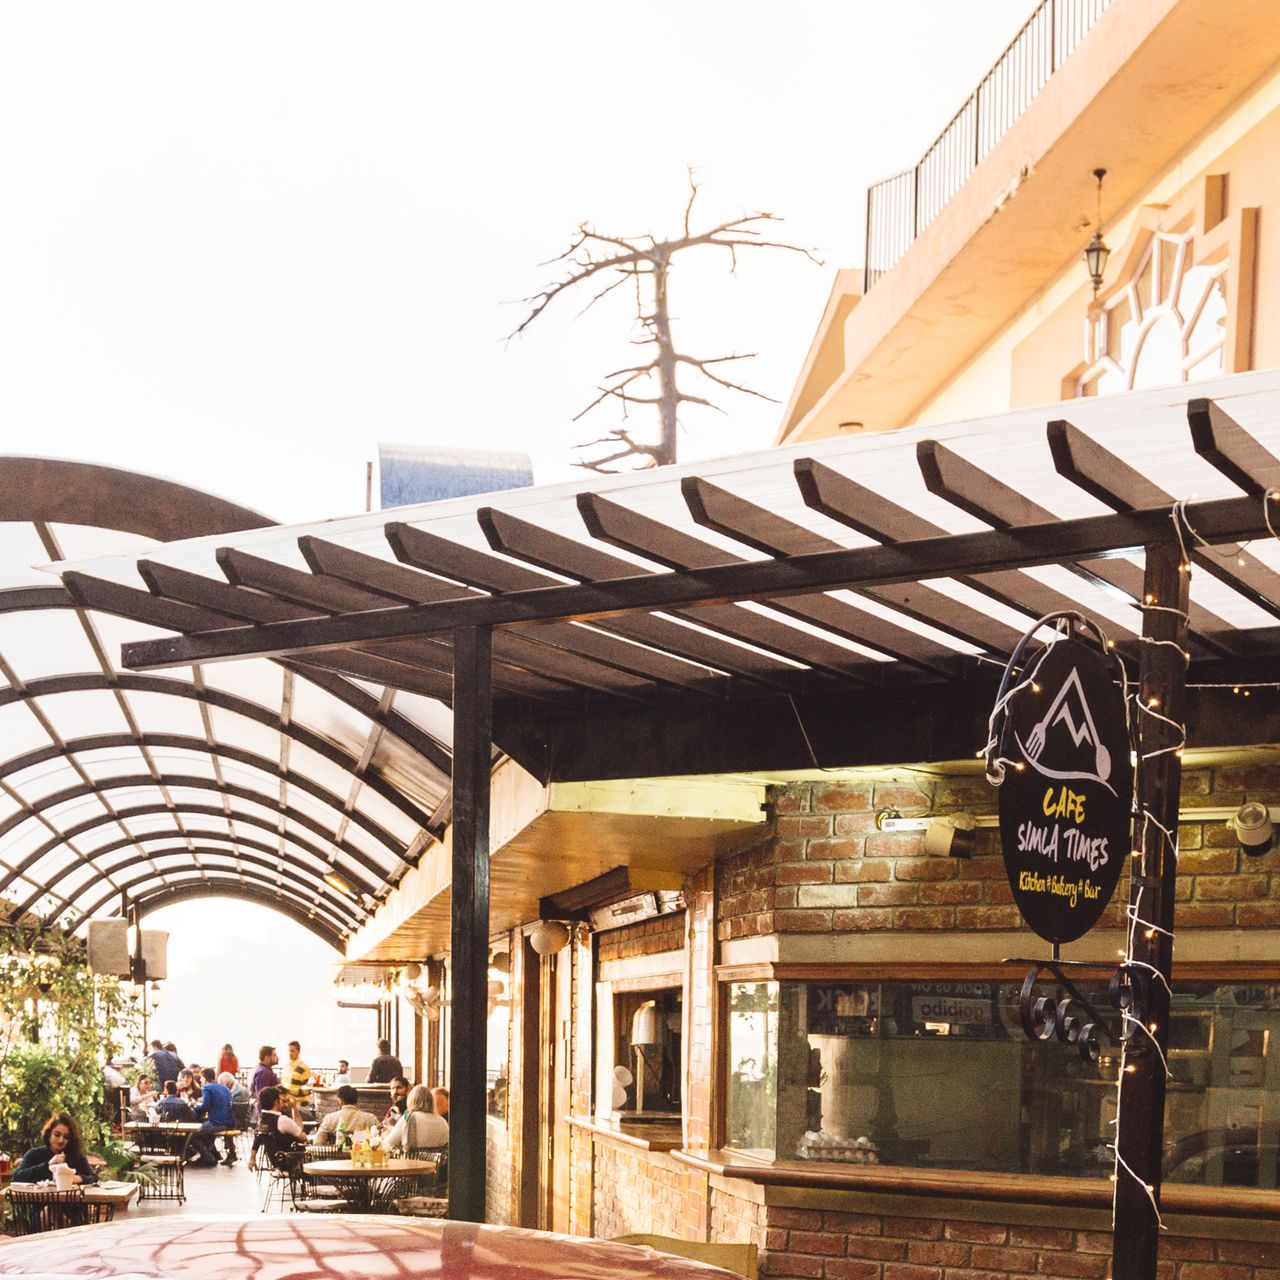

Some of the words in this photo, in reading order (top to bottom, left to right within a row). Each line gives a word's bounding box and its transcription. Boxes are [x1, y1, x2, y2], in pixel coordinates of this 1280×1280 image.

[1043, 785, 1086, 824] CAFE
[1018, 820, 1059, 863] SIMLA
[1063, 827, 1109, 872] TIMES
[1019, 871, 1046, 893] Kitchen
[1051, 875, 1078, 908] Bakery
